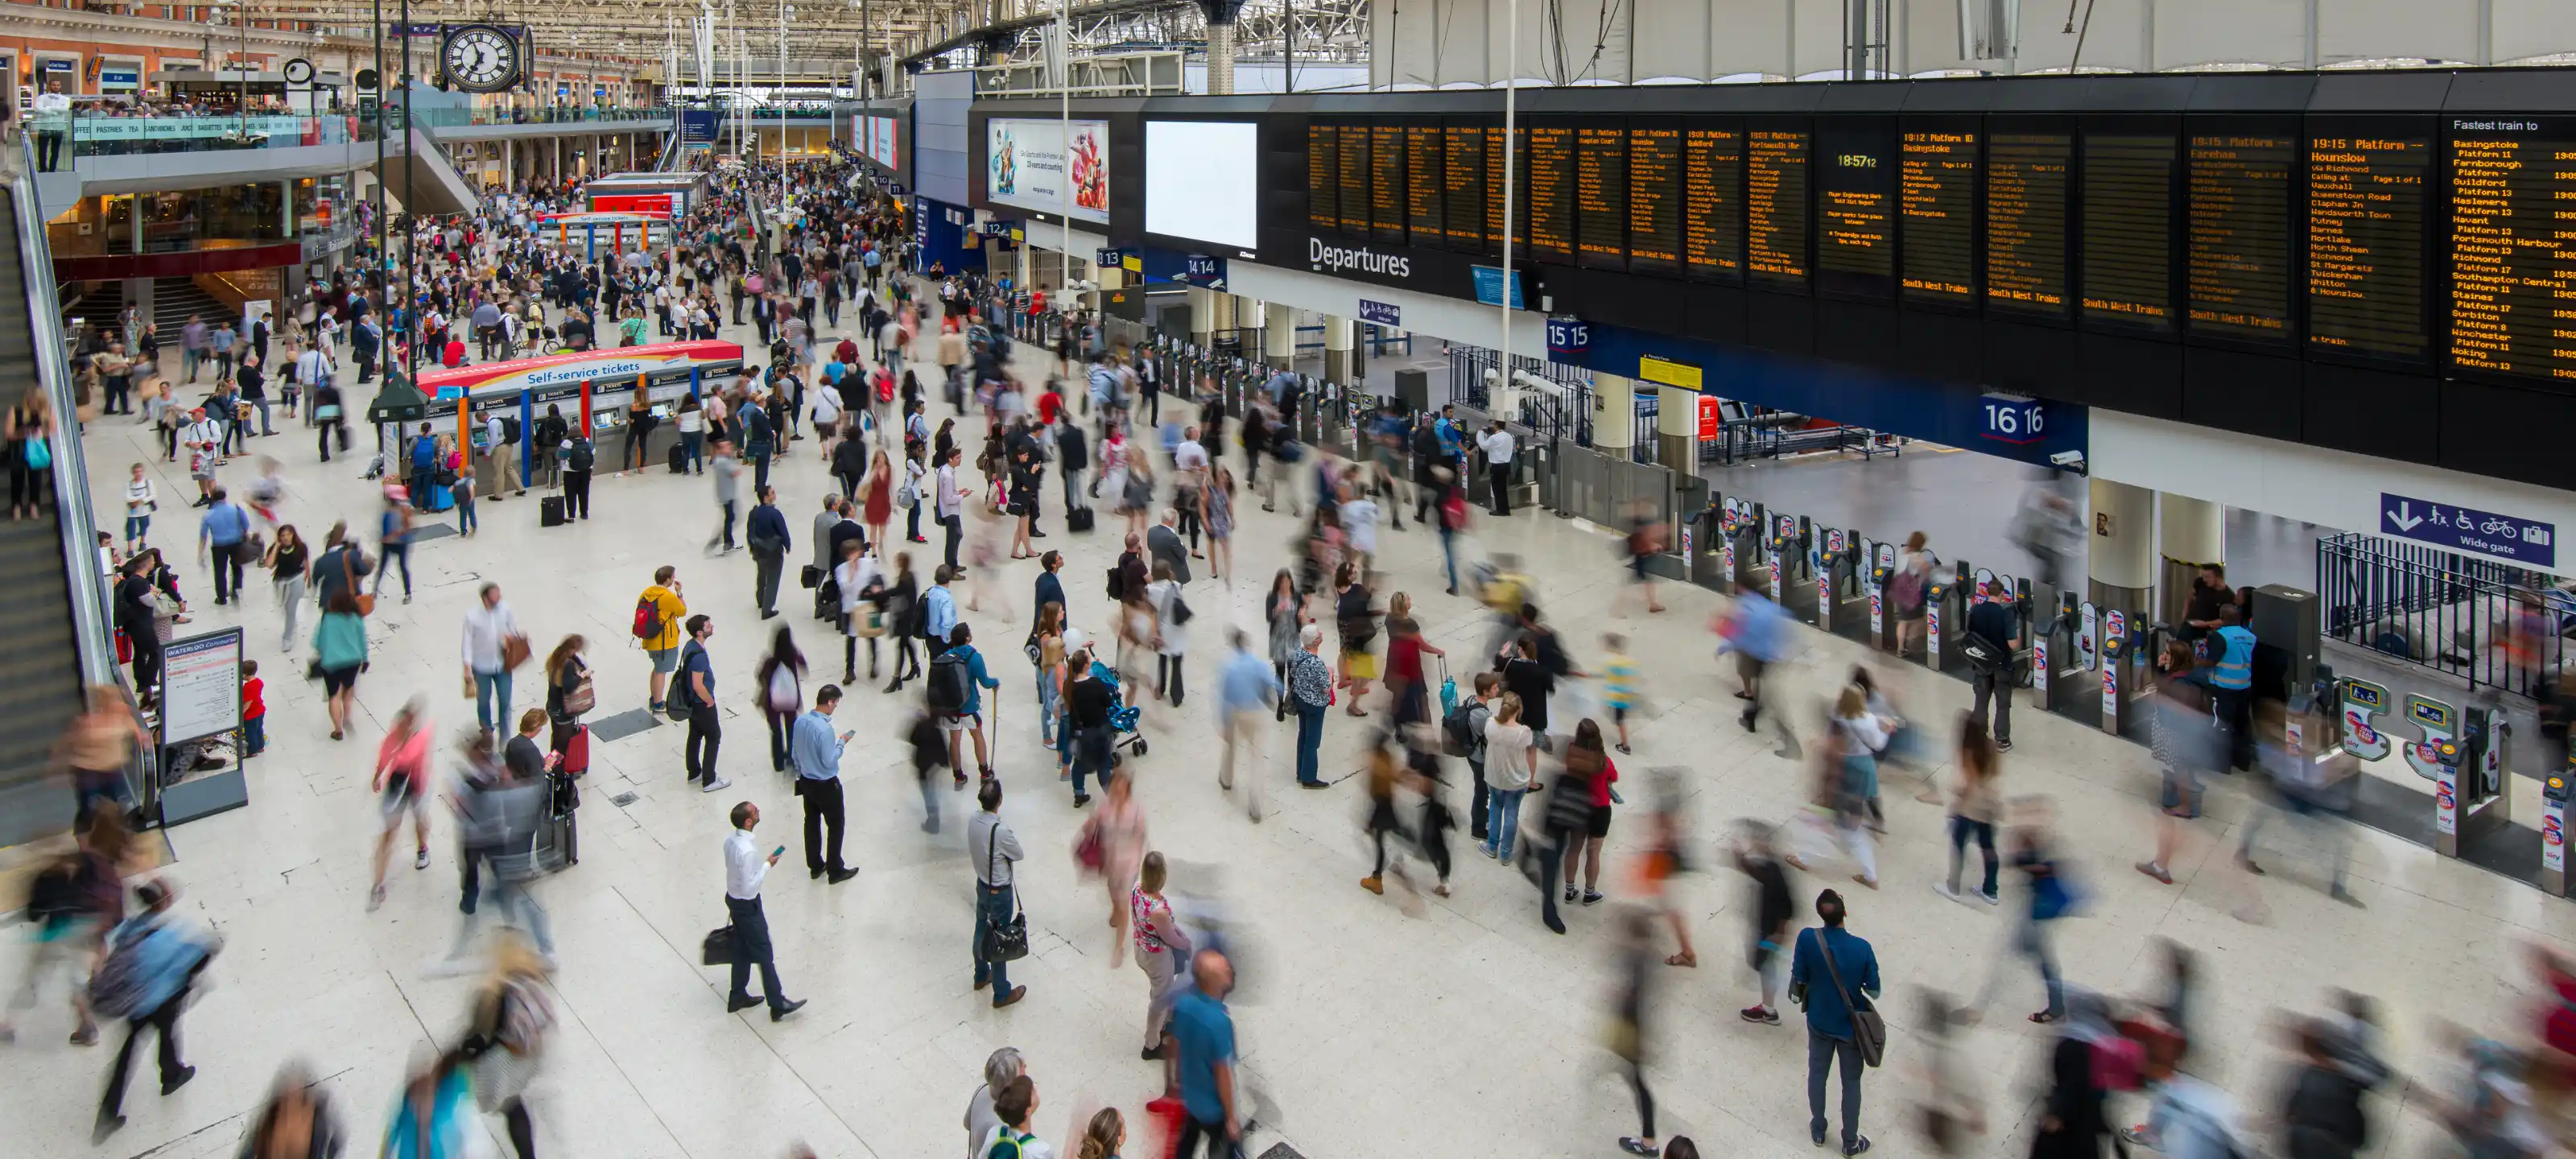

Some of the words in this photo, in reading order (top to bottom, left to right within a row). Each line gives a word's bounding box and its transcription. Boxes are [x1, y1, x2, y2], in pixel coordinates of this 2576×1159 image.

[2454, 120, 2496, 130] Fastest
[2498, 121, 2523, 130] train
[2527, 122, 2538, 130] to
[1905, 134, 1926, 142] 19:12
[1930, 134, 1961, 142] Platform
[2192, 137, 2221, 146] 19:15
[2230, 138, 2273, 147] Platform
[1749, 141, 1785, 149] Portsmouth
[1903, 144, 1951, 154] Basingstoke
[2313, 138, 2346, 149] 19:15
[2355, 139, 2405, 151] Platform
[2454, 140, 2519, 150] Basingstoke
[2190, 149, 2236, 159] Fareham
[2311, 152, 2366, 163] Hounslow
[2458, 150, 2499, 158] Platform
[2502, 151, 2512, 159] 11
[1838, 155, 1867, 167] 18:57
[1868, 158, 1876, 167] 12
[2454, 159, 2521, 169] Farnborough
[2326, 164, 2370, 173] Richmond
[2458, 169, 2499, 177] Platform
[2311, 173, 2337, 182] Calling
[2373, 175, 2393, 184] Page
[2454, 178, 2506, 187] Guildford
[893, 185, 900, 193] 11
[1903, 182, 1942, 190] Farnborough
[2311, 182, 2353, 190] Vauxhall
[2311, 191, 2364, 200] Queenstown
[2458, 188, 2499, 196] Platform
[2502, 189, 2512, 197] 13
[2311, 200, 2348, 208] Clapham
[2453, 197, 2508, 207] Haslemere
[2311, 208, 2364, 217] Wandsworth
[2368, 211, 2391, 219] Town
[2458, 206, 2499, 215] Platform
[2502, 208, 2512, 217] 13
[2310, 217, 2343, 226] Putney
[2453, 216, 2489, 225] Havant
[989, 224, 1000, 233] 12
[2458, 225, 2498, 235] Platform
[2502, 228, 2512, 236] 13
[2310, 235, 2351, 244] Mortlake
[2453, 235, 2512, 245] Portsmouth
[2517, 238, 2562, 248] Harbour
[2341, 245, 2368, 254] Sheen
[2458, 244, 2498, 254] Platform
[2501, 247, 2512, 255] 13
[1105, 252, 1118, 264] 13
[1310, 237, 1409, 277] Departures
[2310, 252, 2353, 262] Richmond
[2453, 254, 2501, 264] Richmond
[1189, 260, 1198, 274] 14
[1200, 260, 1215, 274] 14
[2325, 262, 2373, 272] Margarets
[2457, 263, 2498, 273] Platform
[2311, 270, 2363, 280] Twickenham
[2452, 272, 2519, 284] Southampton
[2523, 278, 2566, 288] Central
[2310, 278, 2346, 287] Whitton
[2457, 282, 2498, 292] Platform
[1988, 287, 2011, 298] South
[2013, 290, 2032, 300] West
[2035, 292, 2061, 303] Trains
[2452, 291, 2494, 301] Staines
[2083, 298, 2107, 310] South
[2111, 301, 2132, 311] West
[2135, 303, 2164, 316] Trains
[2457, 301, 2497, 311] Platform
[2500, 304, 2511, 312] 17
[2452, 309, 2500, 321] Surbiton
[2457, 320, 2497, 330] Platform
[1549, 325, 1566, 345] 15
[1571, 326, 1587, 345] 15
[2452, 328, 2512, 341] Winchester
[2457, 338, 2497, 349] Platform
[2500, 343, 2509, 351] 11
[2451, 347, 2487, 359] Woking
[2456, 357, 2496, 369] Platform
[2553, 369, 2576, 378] 19:00
[528, 368, 598, 384] Self-service
[601, 362, 640, 377] tickets
[1985, 405, 2017, 433] 16
[2025, 406, 2043, 434] 16
[2460, 535, 2487, 549] Wide
[2490, 542, 2515, 555] gate
[167, 644, 204, 657] WATERLOO
[205, 637, 237, 648] Concourse
[2346, 740, 2359, 749] sky
[2439, 815, 2452, 824] sky
[2545, 852, 2560, 861] sky
